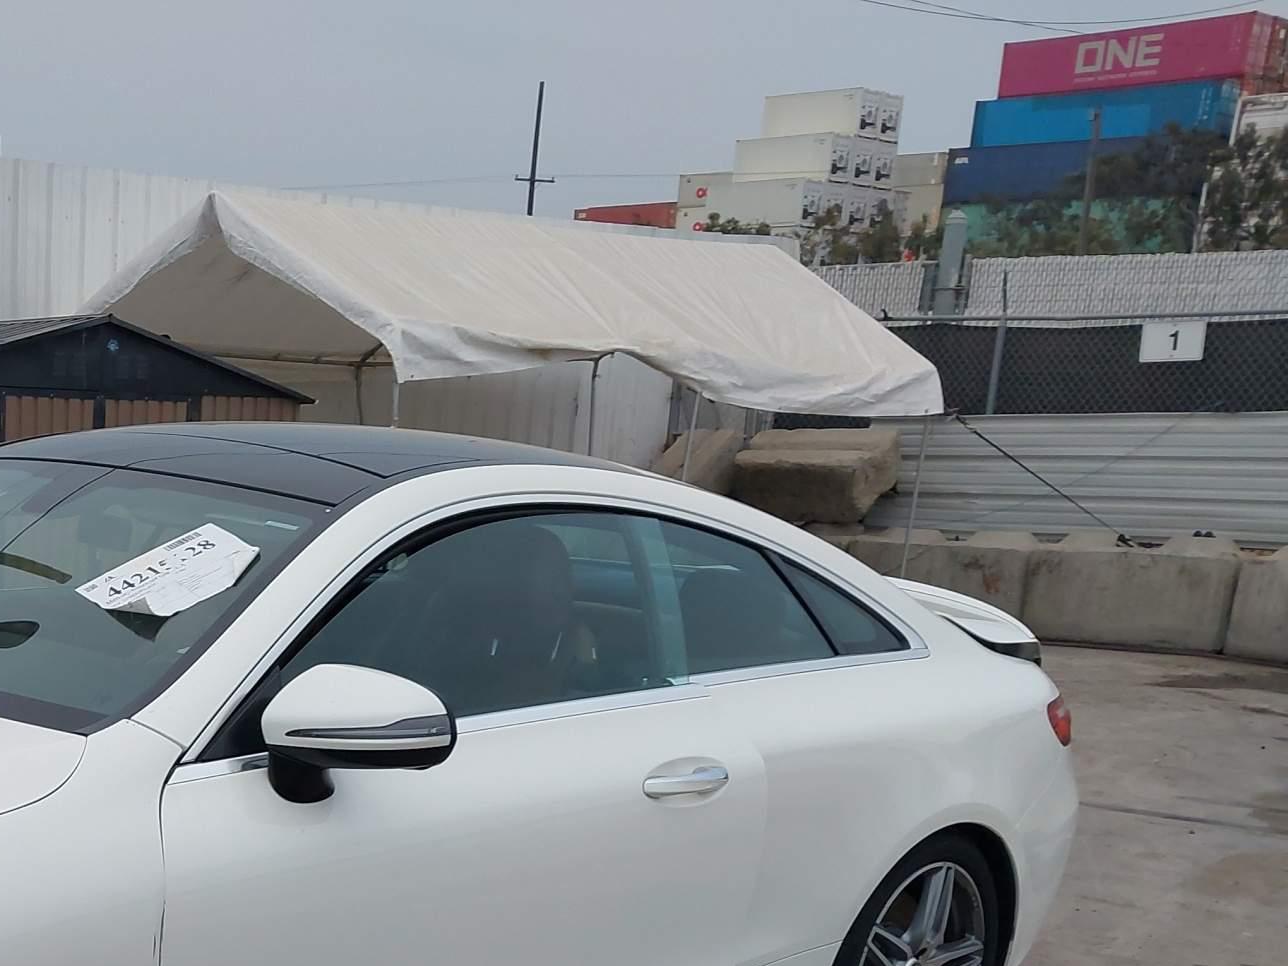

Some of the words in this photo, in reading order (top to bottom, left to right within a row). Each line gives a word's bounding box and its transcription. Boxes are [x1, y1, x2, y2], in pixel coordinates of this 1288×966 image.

[1074, 33, 1164, 74] ONE
[1168, 330, 1180, 351] 1
[107, 539, 217, 599] 4421528
